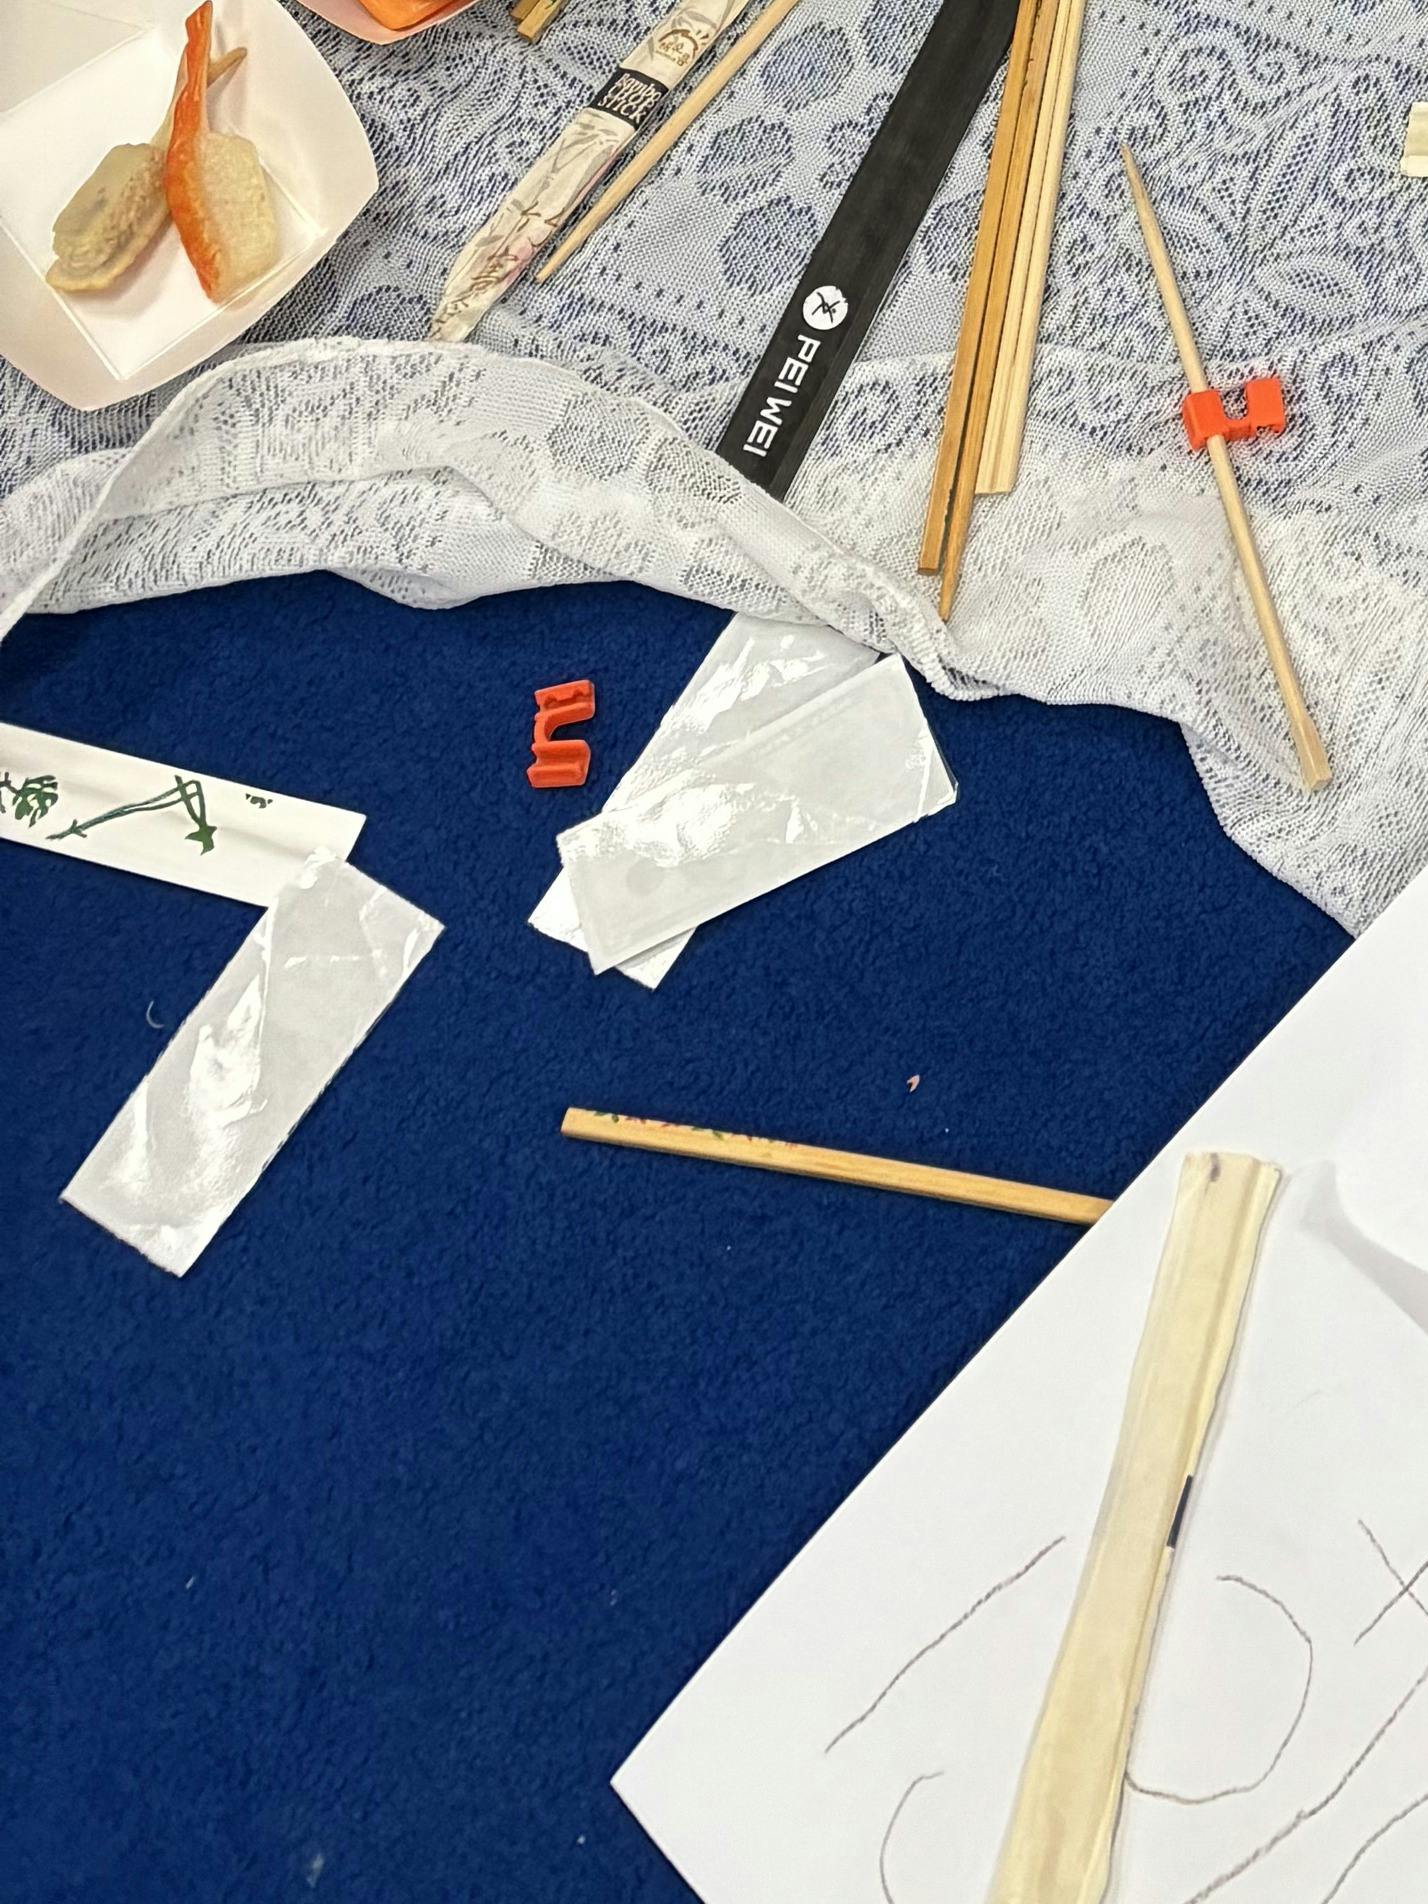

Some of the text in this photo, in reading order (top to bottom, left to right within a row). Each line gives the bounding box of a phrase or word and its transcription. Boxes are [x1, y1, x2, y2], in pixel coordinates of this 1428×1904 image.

[597, 95, 648, 124] STICK
[742, 334, 822, 457] PEI WEI
